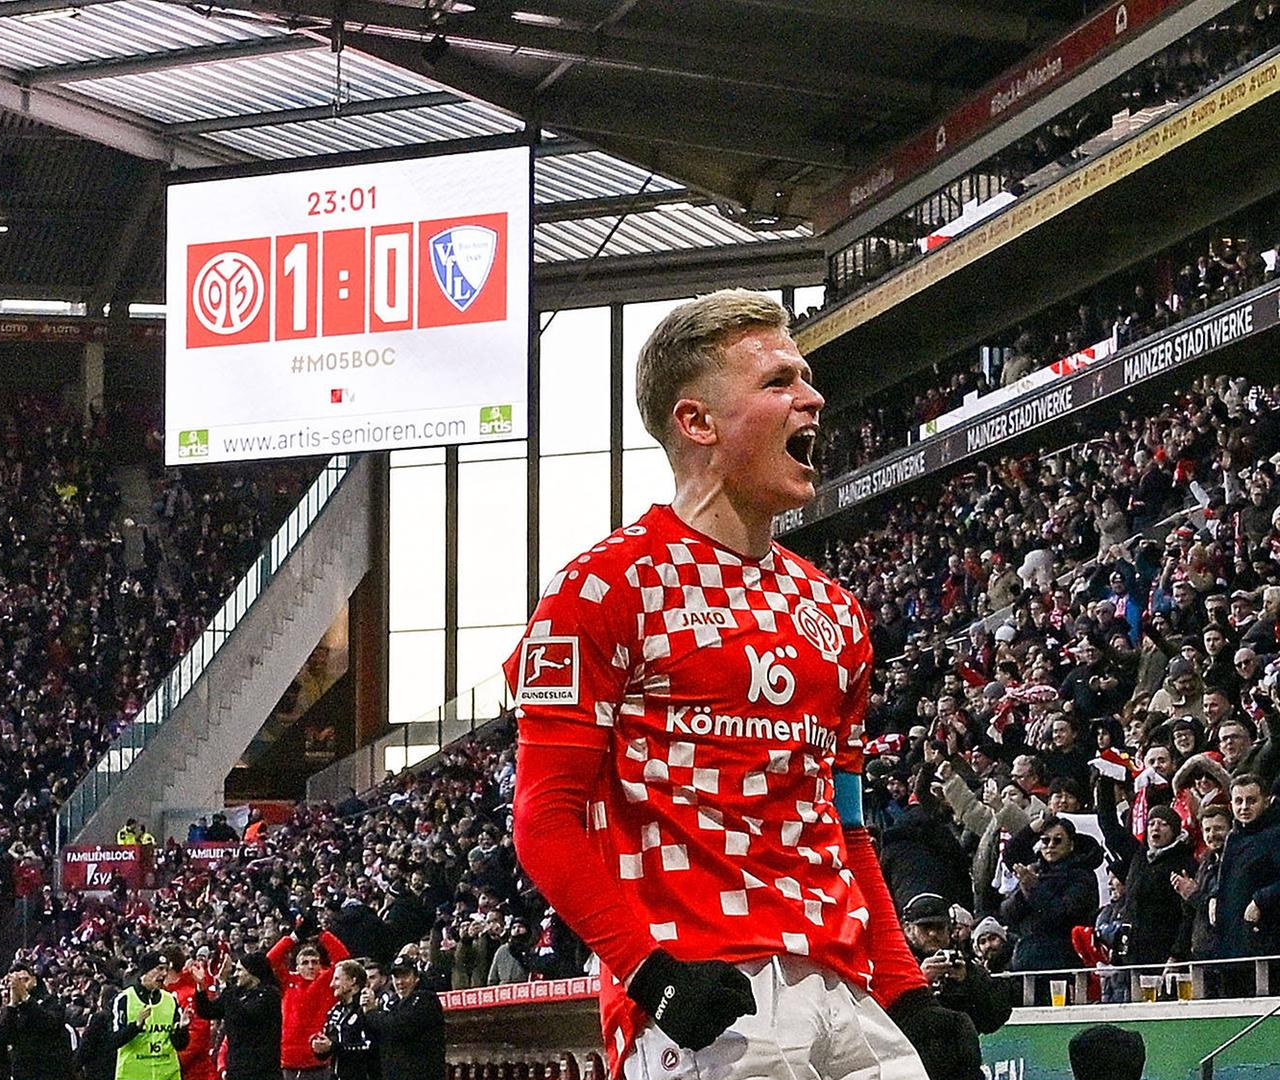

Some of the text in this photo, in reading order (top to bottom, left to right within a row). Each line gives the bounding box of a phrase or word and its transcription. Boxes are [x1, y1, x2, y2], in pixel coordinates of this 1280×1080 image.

[308, 186, 377, 216] 23:01
[1124, 305, 1253, 385] MAINZER STADTWERKE
[292, 347, 396, 373] #M05BOC
[480, 418, 512, 435] artis
[967, 386, 1073, 452] MAINZER STADTWERKE
[223, 417, 467, 454] www.artis-senioren.com
[681, 611, 726, 628] JAKO
[521, 690, 574, 701] BUNDESLIGA
[66, 850, 135, 862] FAMILIENBLOCK
